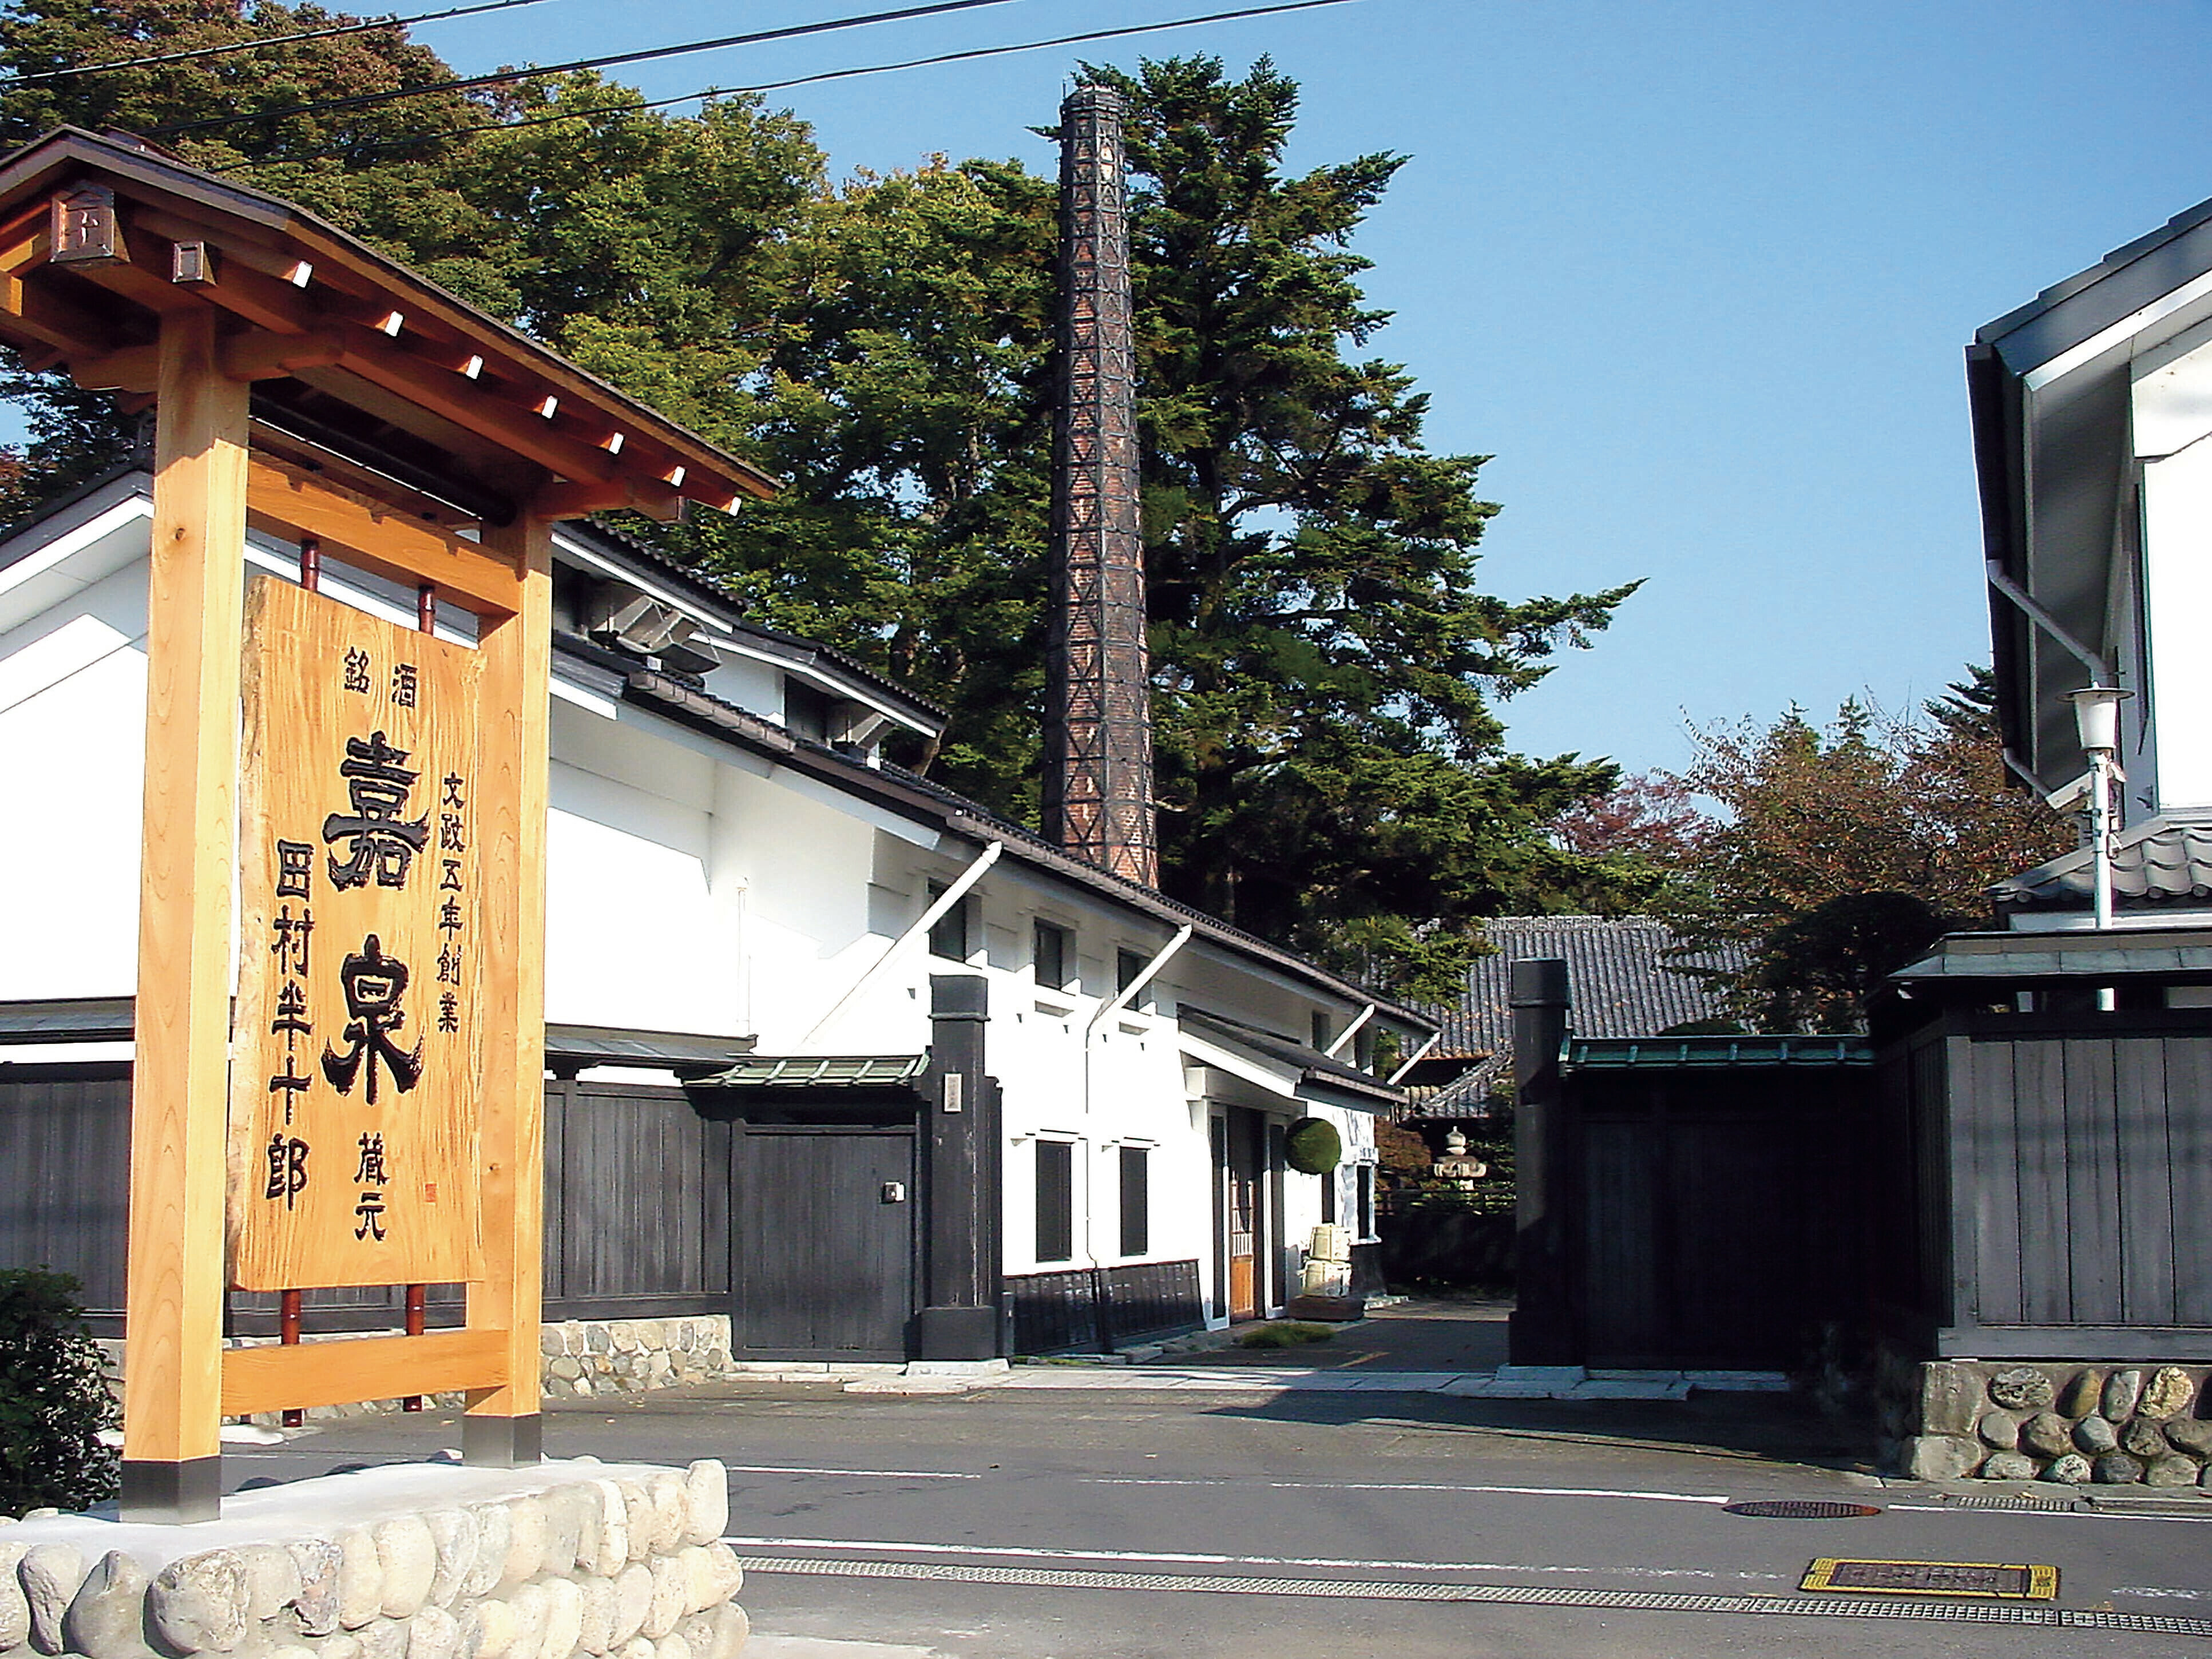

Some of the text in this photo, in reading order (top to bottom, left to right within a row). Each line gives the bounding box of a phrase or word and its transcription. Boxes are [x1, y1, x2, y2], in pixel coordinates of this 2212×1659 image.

[320, 729, 430, 1106] 嘉泉
[436, 771, 465, 1033] 文政五年創業
